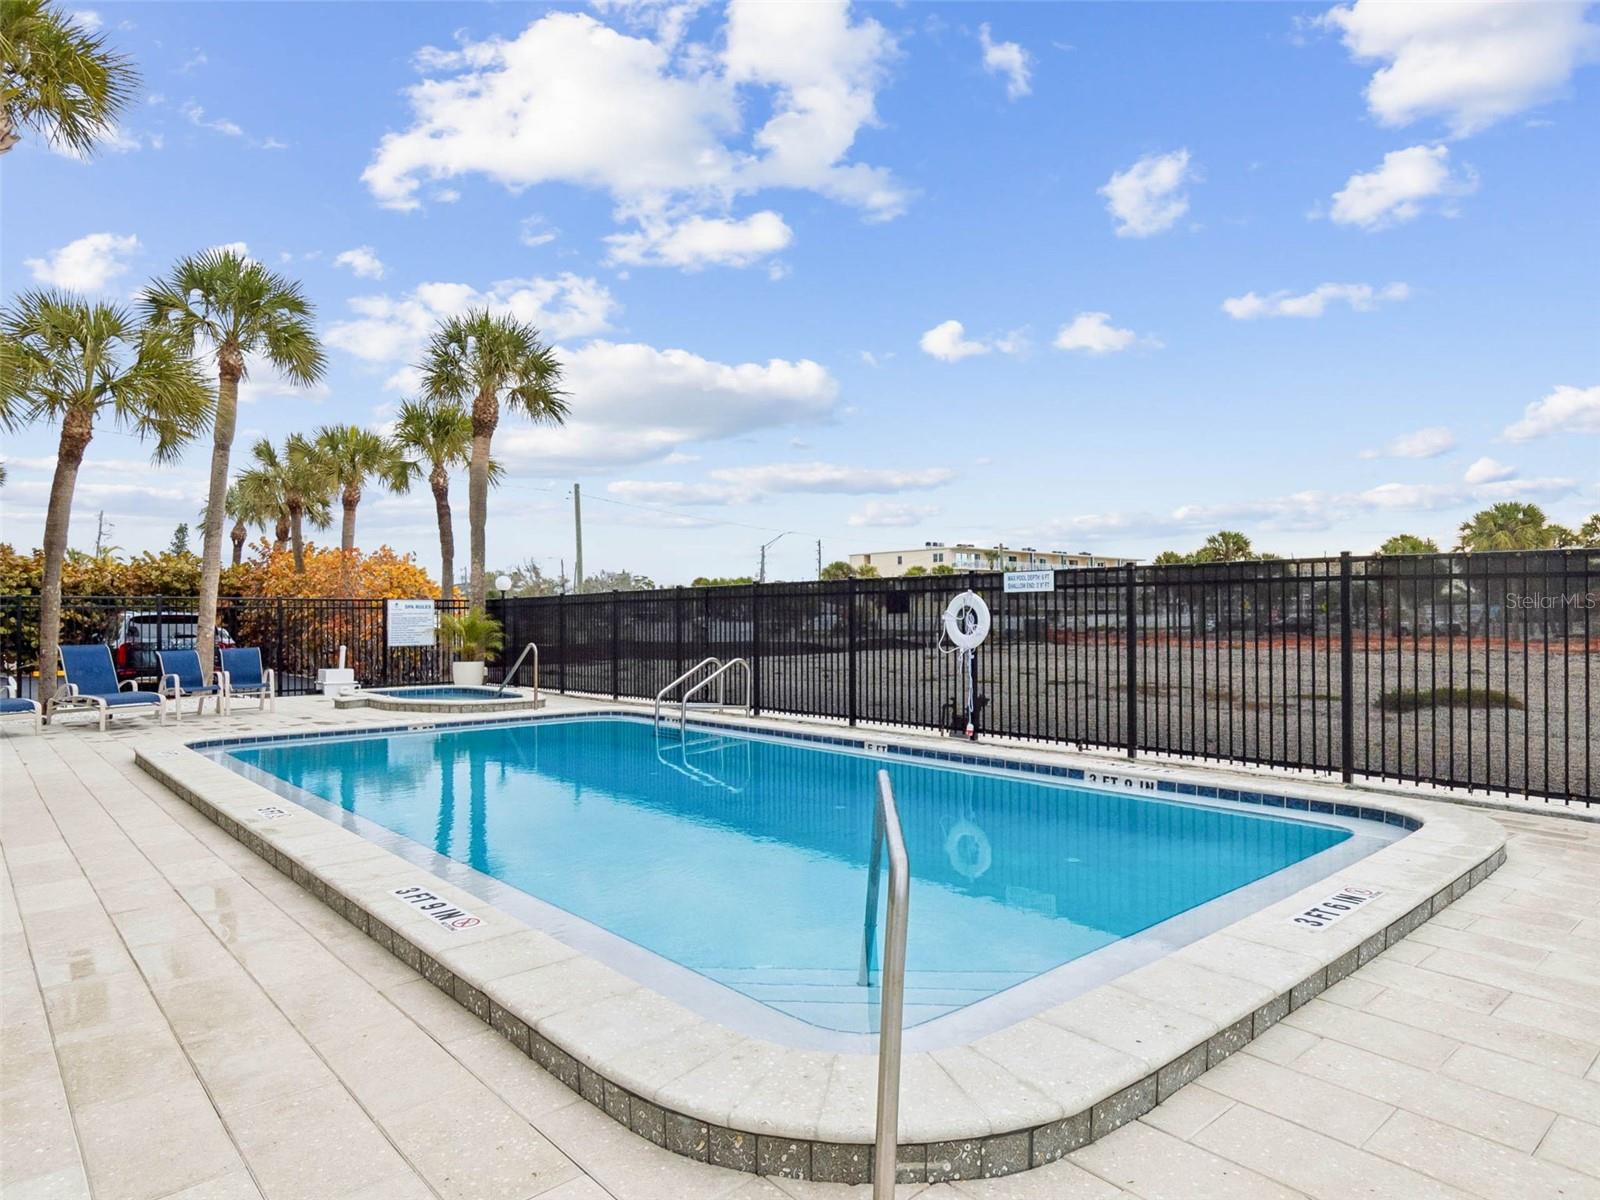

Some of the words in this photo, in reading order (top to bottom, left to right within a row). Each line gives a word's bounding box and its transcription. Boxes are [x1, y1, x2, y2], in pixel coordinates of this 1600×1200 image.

[1102, 775, 1118, 785] FT
[1140, 780, 1154, 790] IN
[394, 887, 421, 895] 3
[403, 892, 438, 904] FT
[1331, 893, 1367, 905] IN
[420, 902, 447, 910] 9
[1322, 902, 1351, 911] 6
[430, 908, 466, 921] IN
[1303, 907, 1341, 921] FT
[1293, 917, 1324, 927] 3
